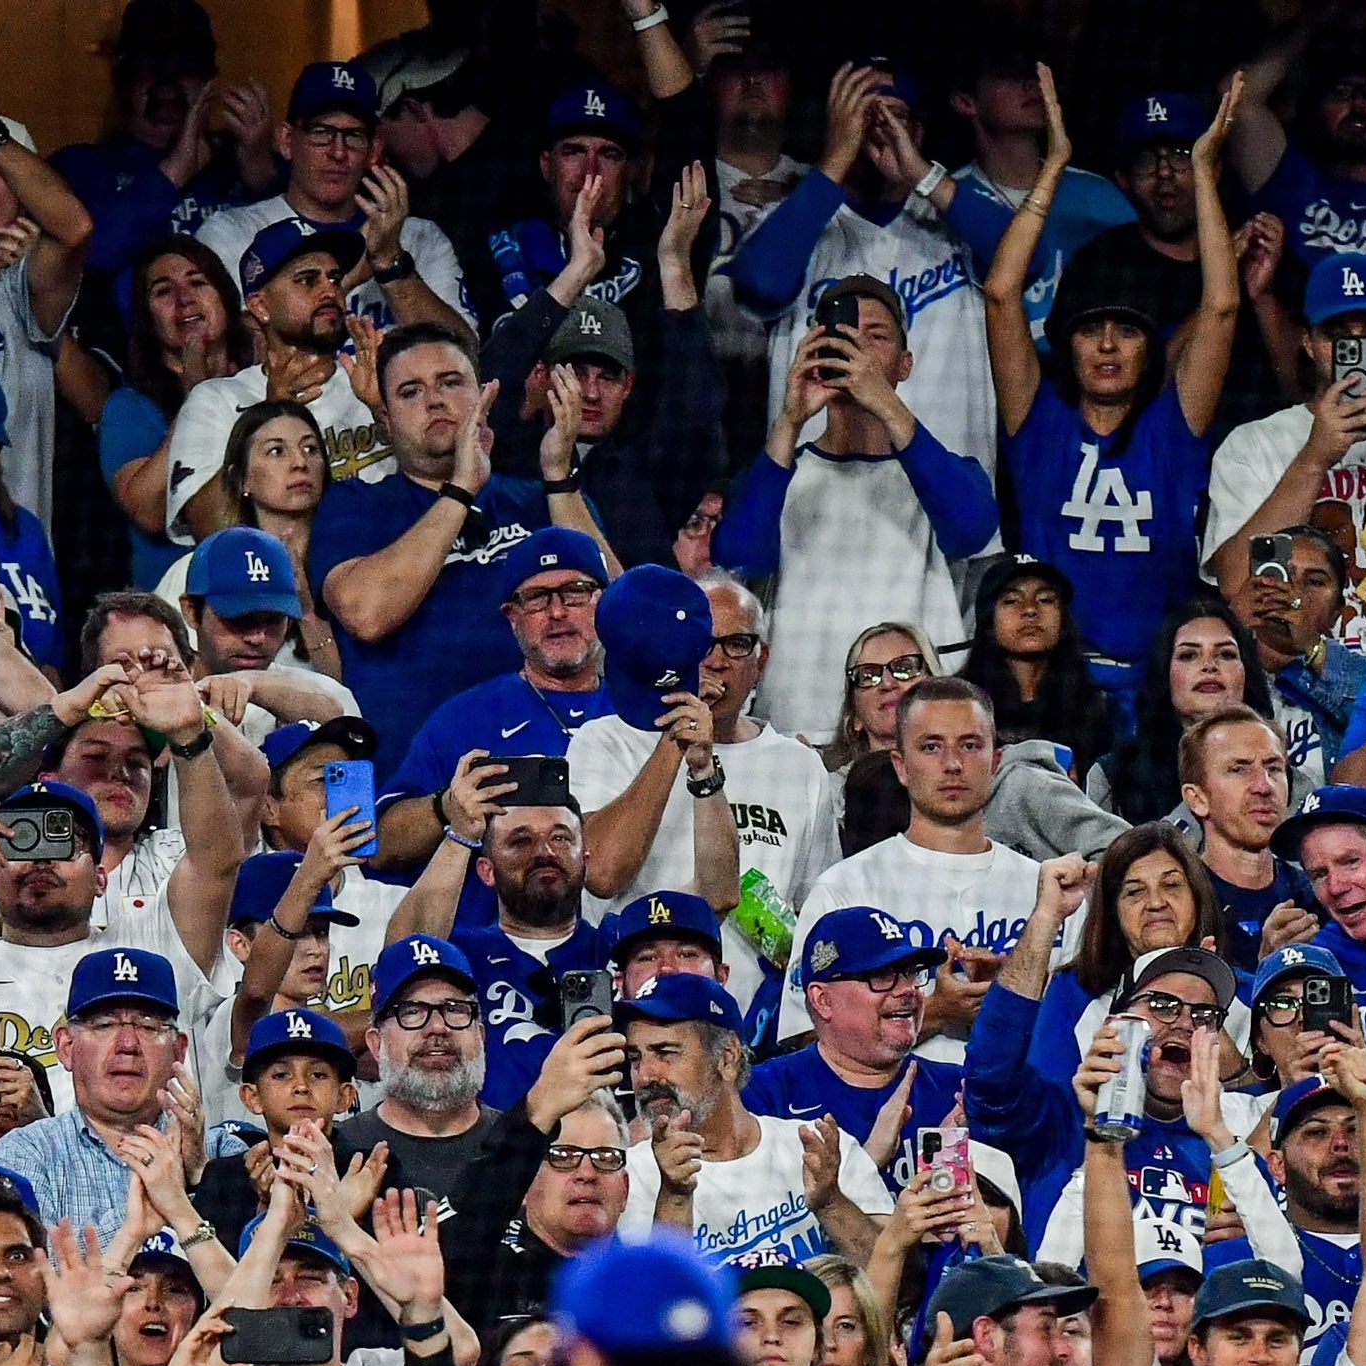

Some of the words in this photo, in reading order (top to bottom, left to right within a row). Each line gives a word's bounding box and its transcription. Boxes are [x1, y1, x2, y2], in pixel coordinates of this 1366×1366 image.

[332, 66, 355, 91] LA
[584, 90, 606, 118] LA
[1146, 97, 1168, 121] LA
[1343, 268, 1366, 295] LA
[580, 311, 602, 335] LA
[1062, 441, 1154, 551] LA
[246, 551, 270, 581] LA
[1, 561, 57, 624] LA
[1301, 793, 1321, 813] LA
[733, 803, 787, 836] USA
[647, 897, 671, 924] LA
[875, 913, 901, 939] LA
[114, 952, 138, 981] LA
[412, 941, 440, 965] LA
[1281, 949, 1306, 966] LA
[287, 1013, 312, 1038] LA
[695, 1227, 727, 1252] Los
[727, 1195, 807, 1248] Angele
[1154, 1225, 1183, 1252] LA
